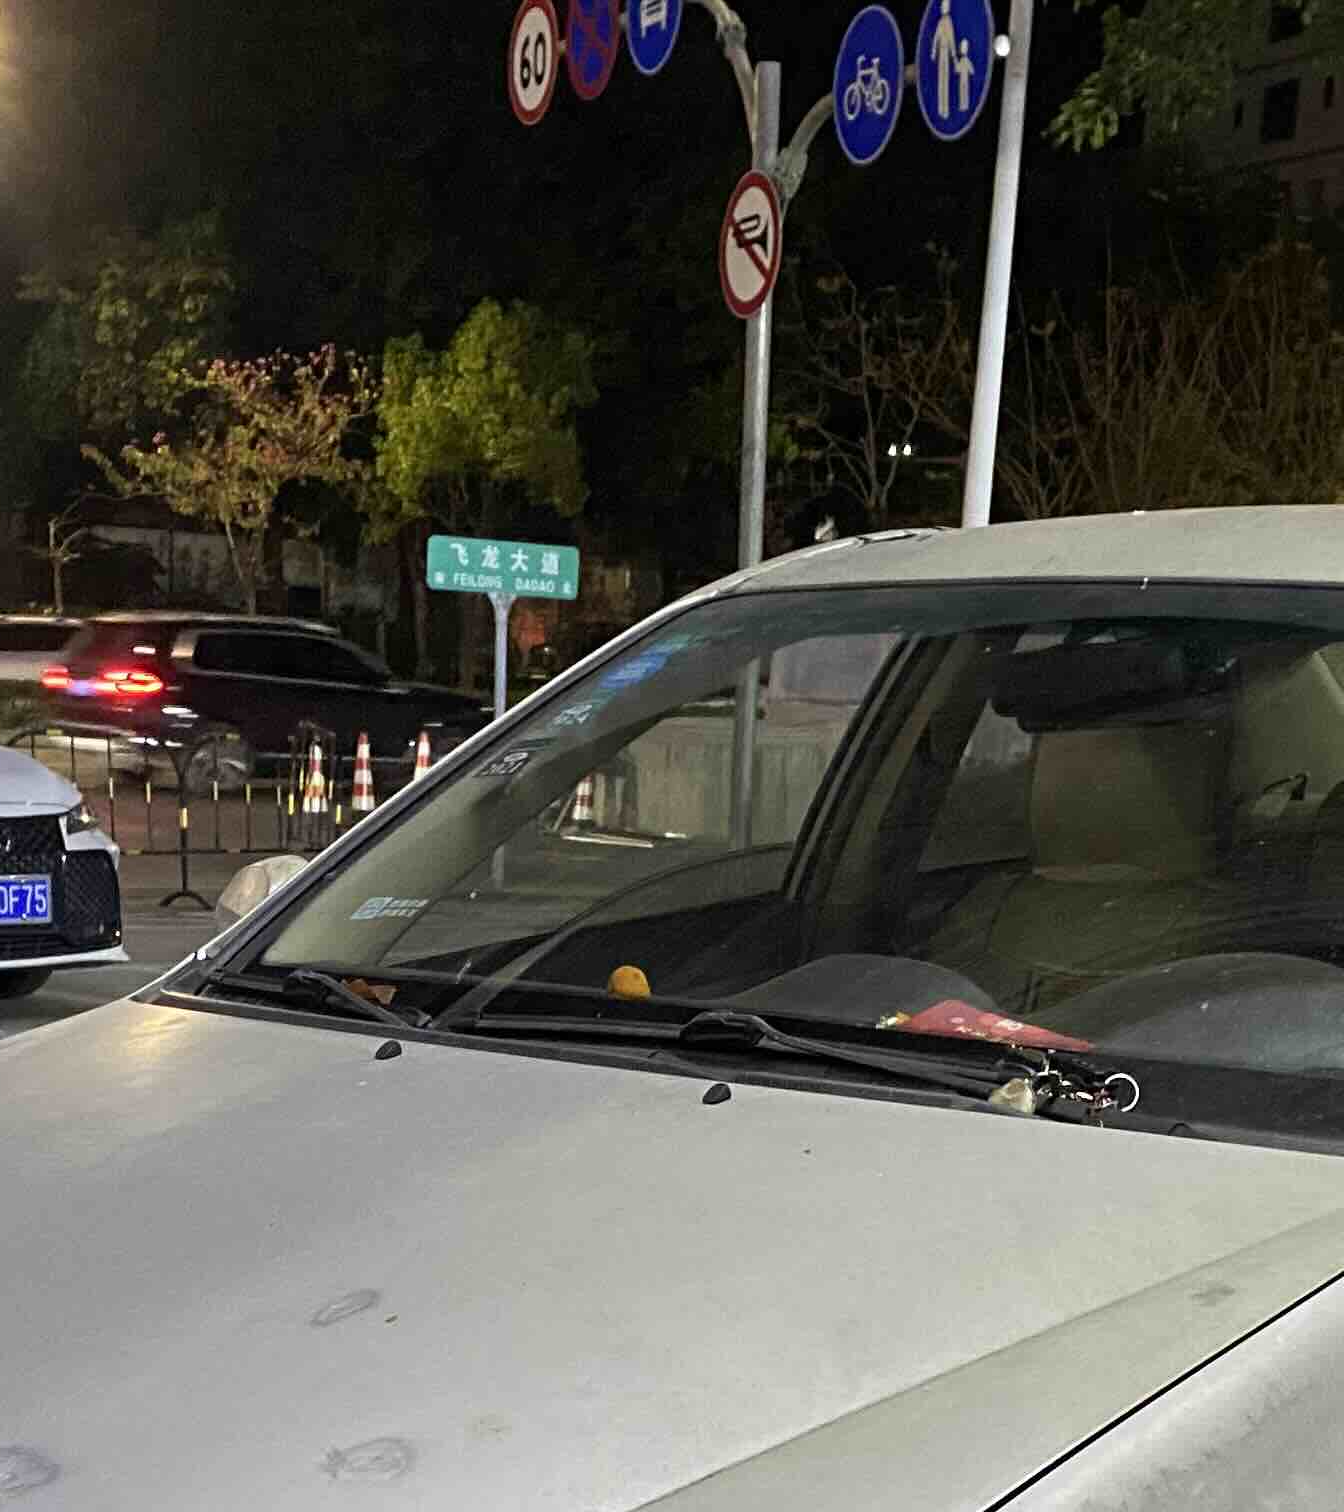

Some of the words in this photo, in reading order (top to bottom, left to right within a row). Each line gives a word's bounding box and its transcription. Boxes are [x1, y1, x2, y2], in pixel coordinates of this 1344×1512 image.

[520, 32, 546, 89] 60
[449, 543, 560, 576] 飞龙大道
[453, 572, 505, 590] FEILONG
[515, 577, 555, 594] DADAO
